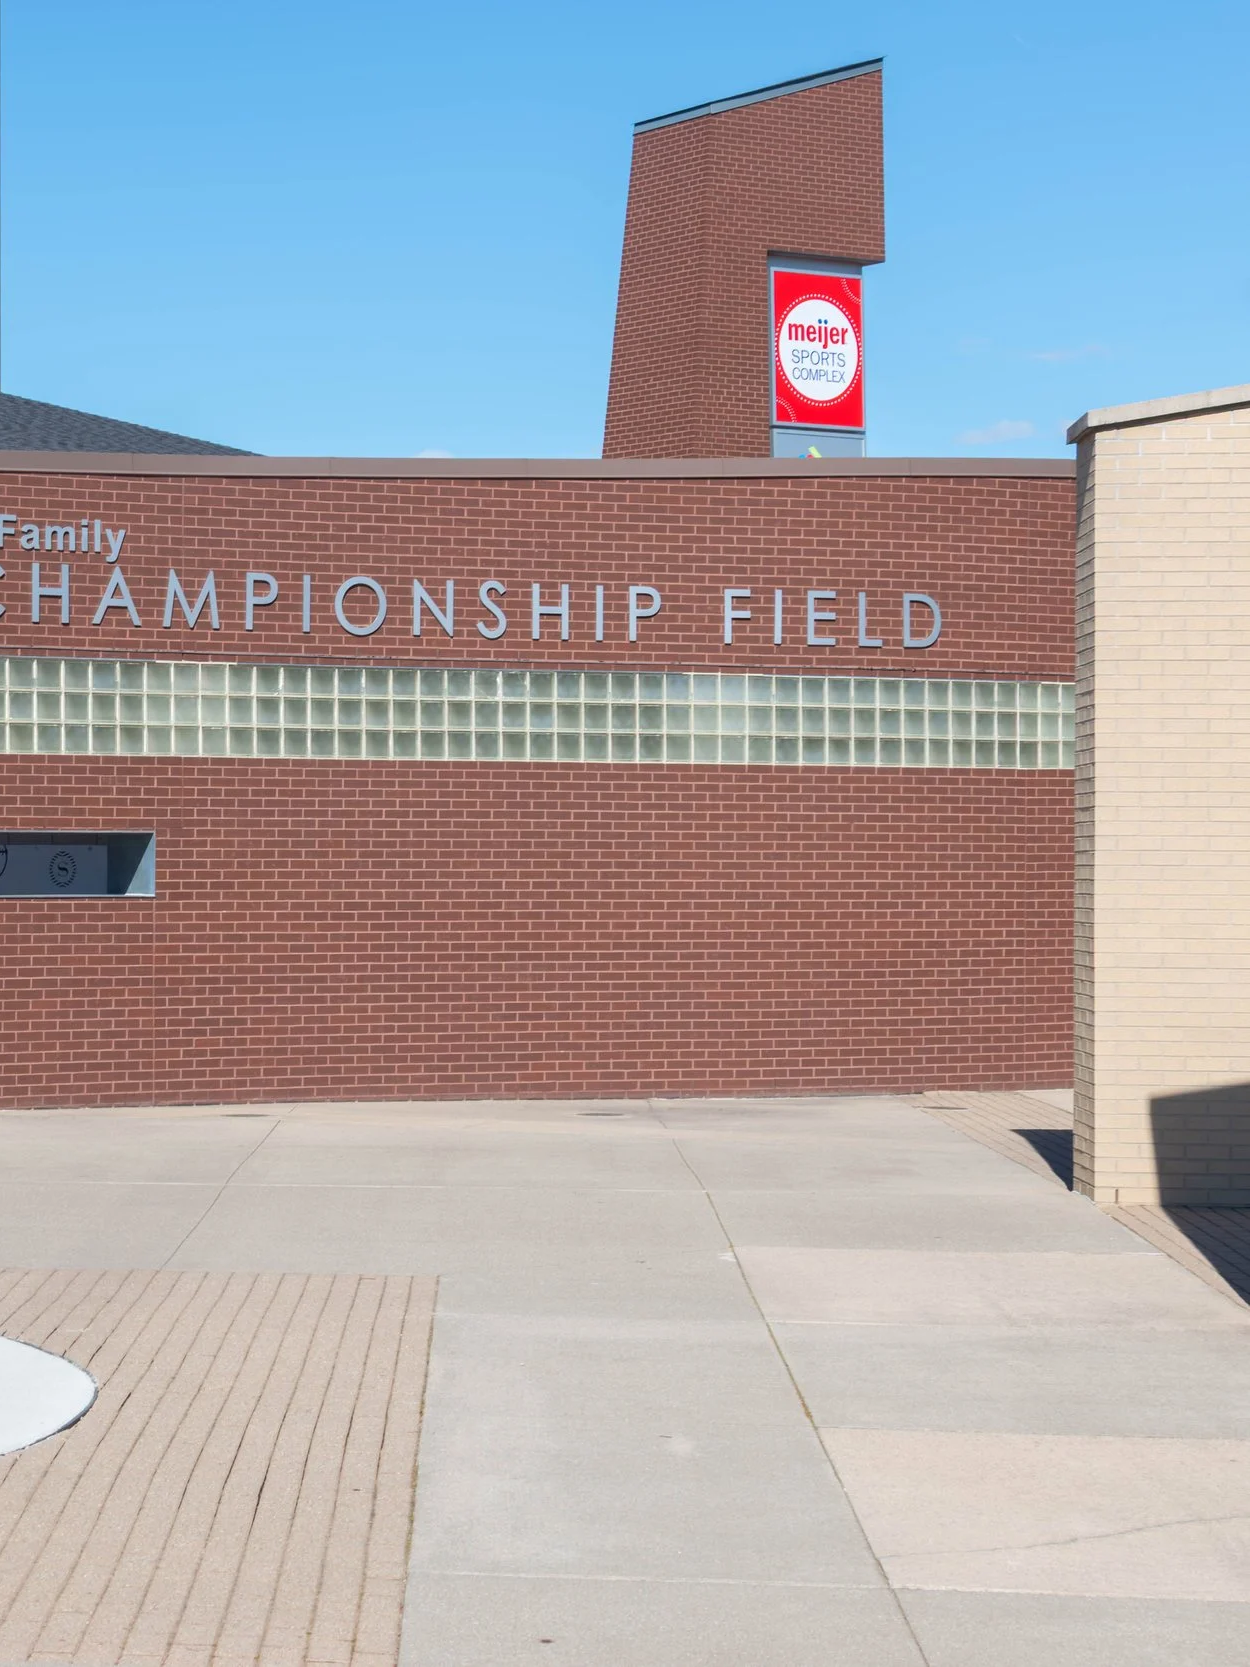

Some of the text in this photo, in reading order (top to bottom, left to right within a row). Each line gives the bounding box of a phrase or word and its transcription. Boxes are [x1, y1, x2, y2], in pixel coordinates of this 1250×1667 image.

[788, 319, 848, 349] meijer
[791, 349, 846, 368] SPORTS
[792, 367, 846, 383] COMPLEX
[724, 587, 943, 648] FIELD
